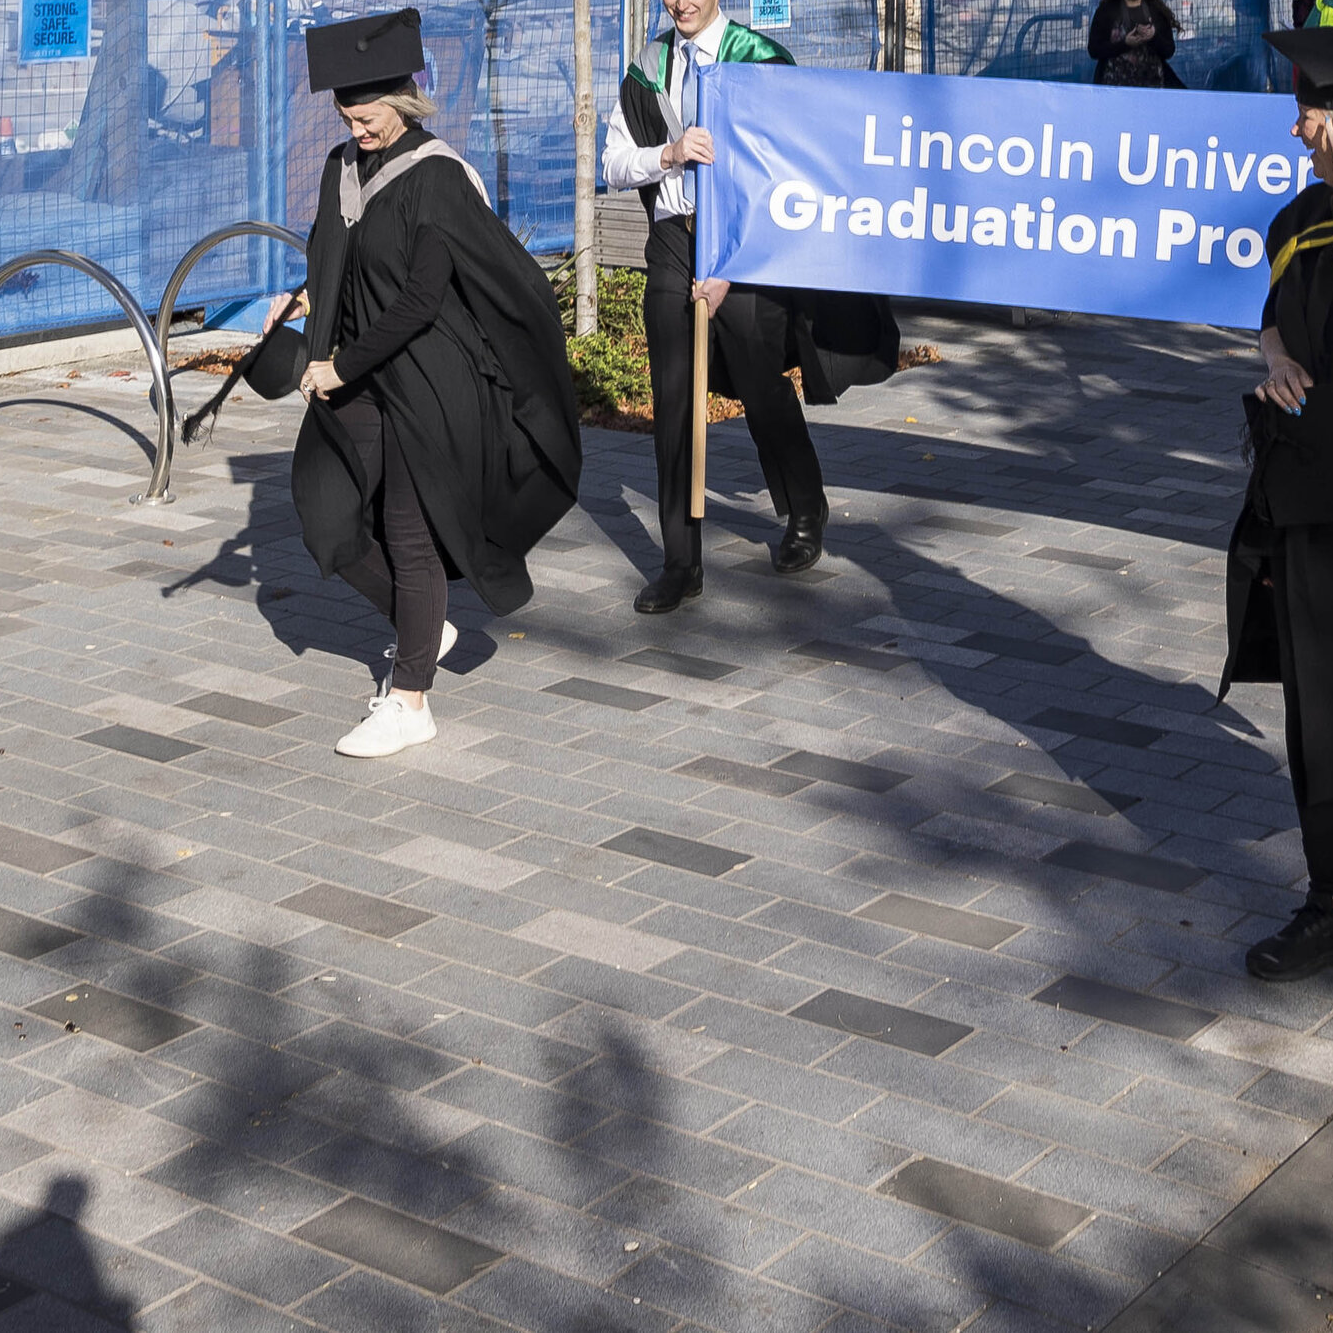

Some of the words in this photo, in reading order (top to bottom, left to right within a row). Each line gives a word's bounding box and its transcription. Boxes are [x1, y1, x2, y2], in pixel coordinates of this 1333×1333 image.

[34, 2, 78, 17] STRONG.
[41, 17, 71, 31] SAFE.
[33, 31, 77, 46] SECURE.
[862, 114, 1094, 182] Lincoln
[768, 180, 1138, 259] Graduation
